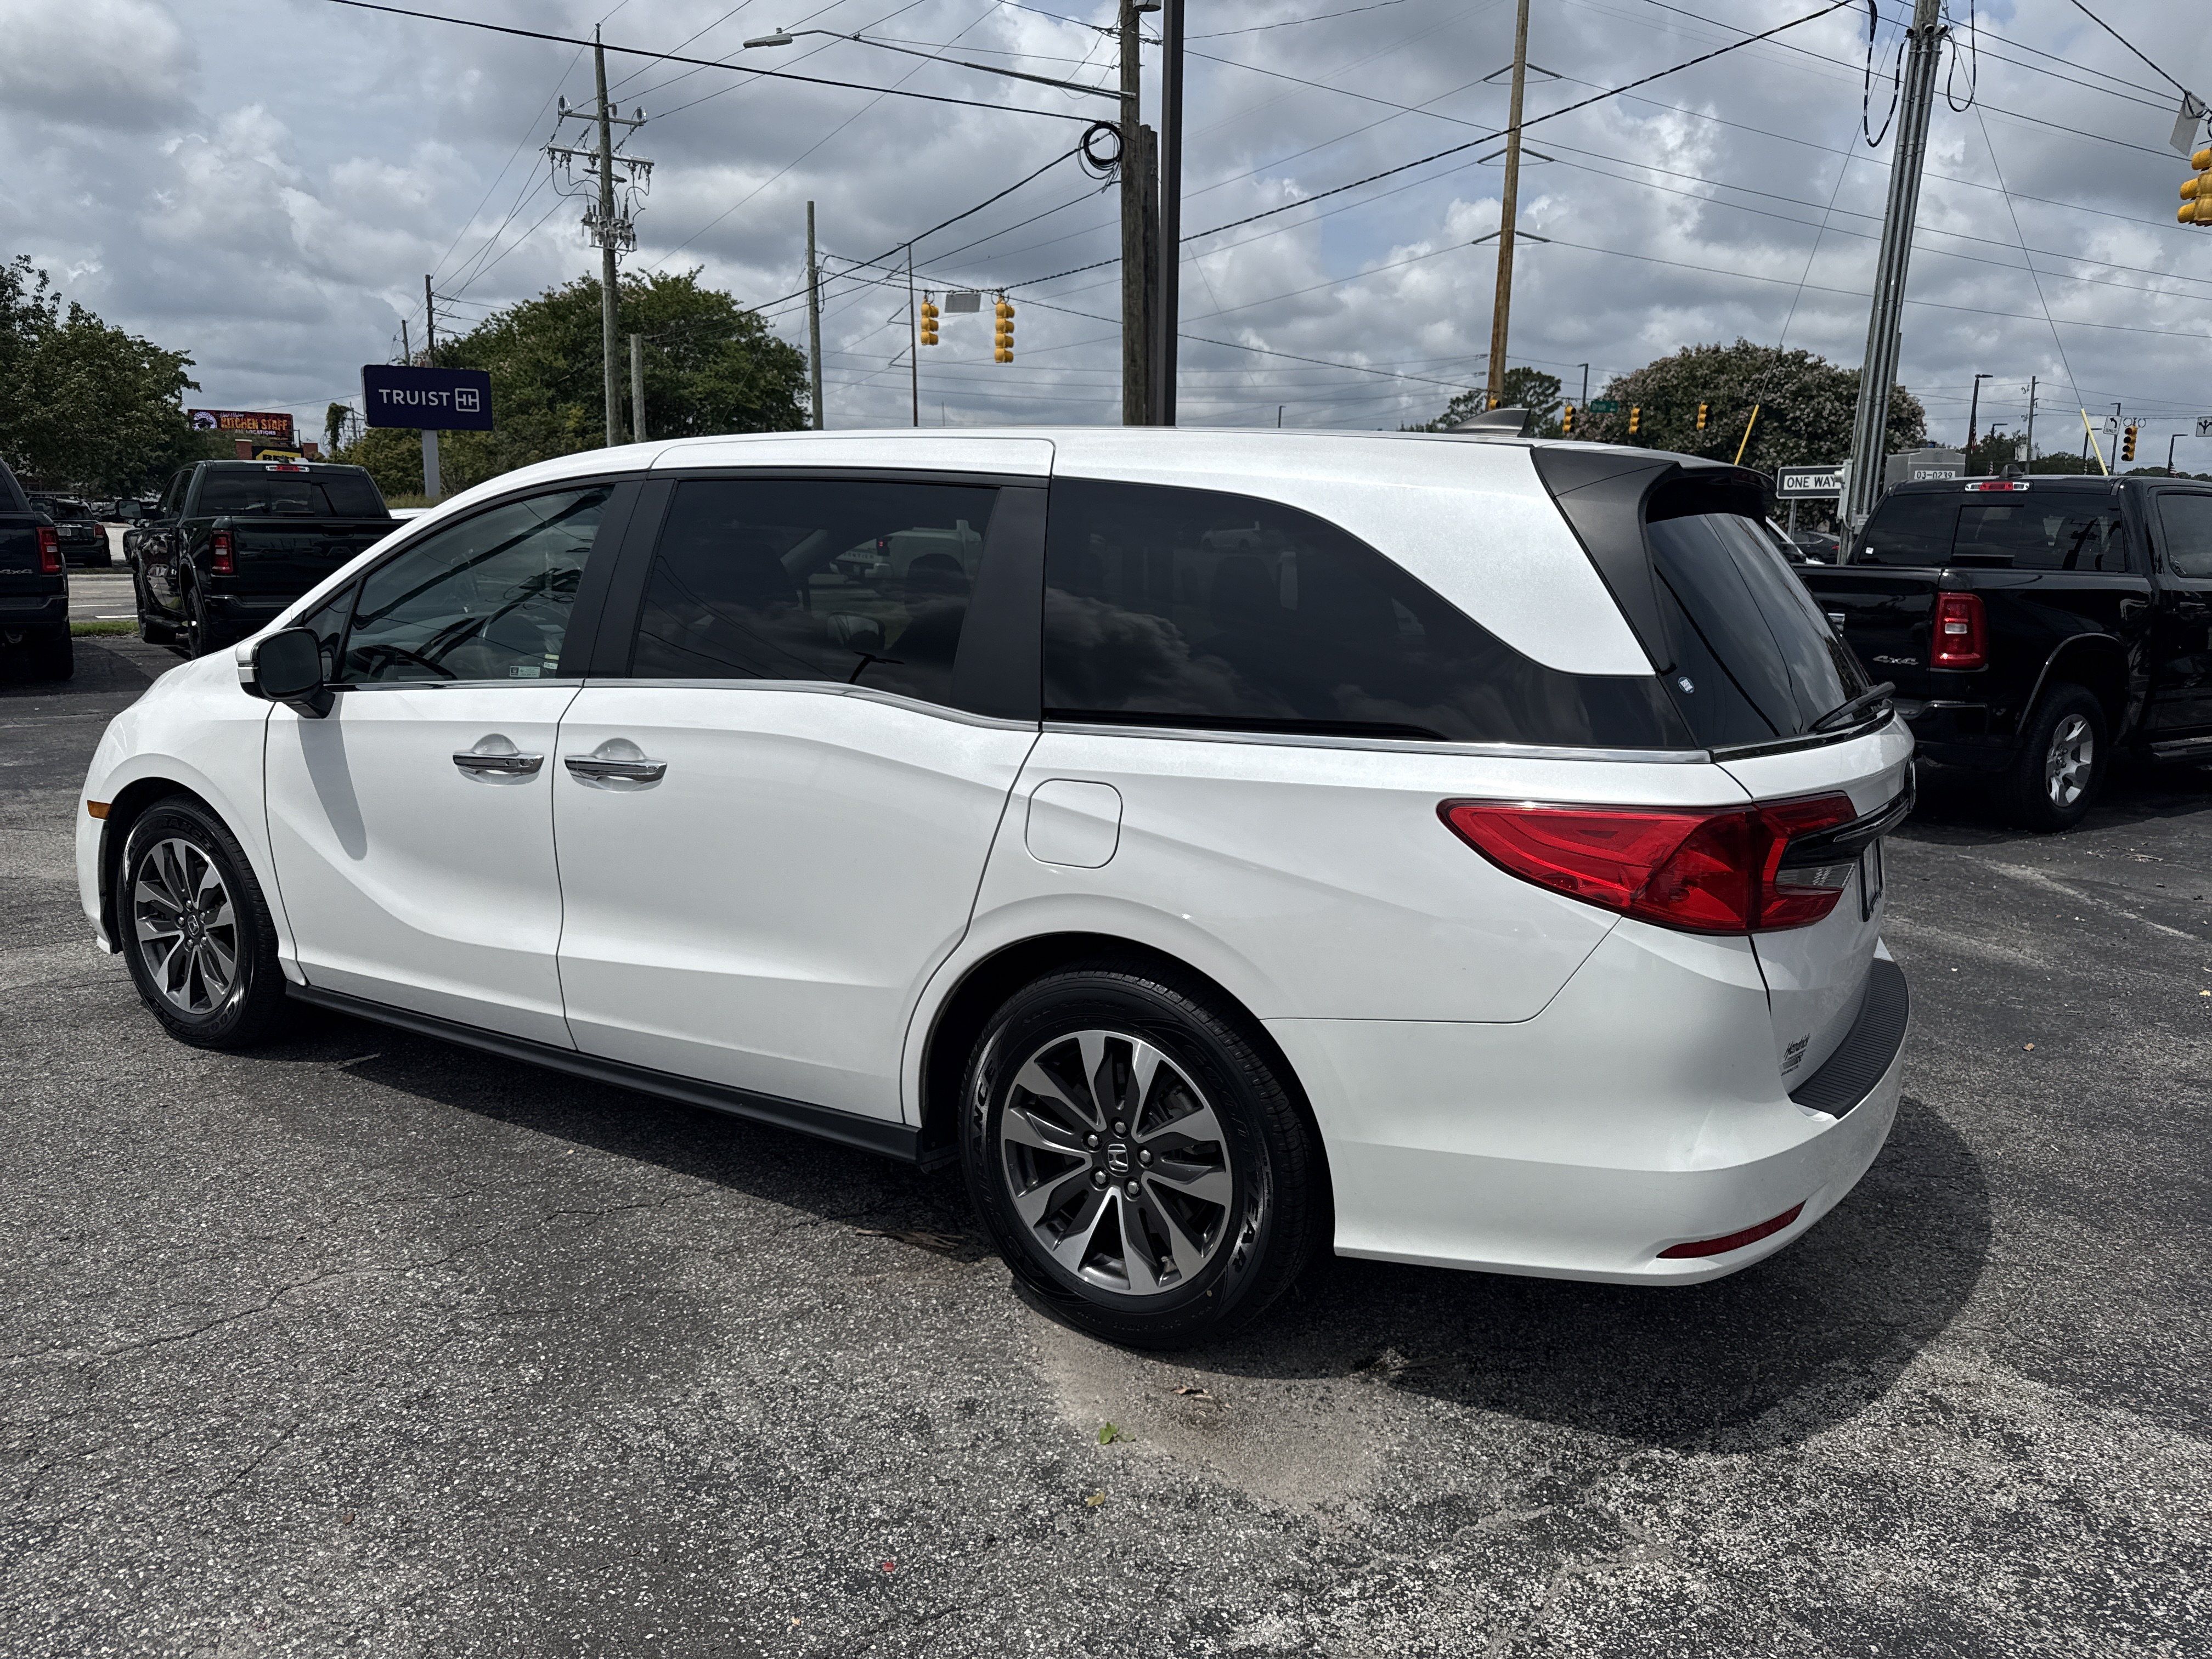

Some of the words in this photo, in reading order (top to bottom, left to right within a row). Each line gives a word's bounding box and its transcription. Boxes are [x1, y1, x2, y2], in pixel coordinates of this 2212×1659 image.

[378, 388, 450, 407] TRUIST
[221, 417, 259, 430] KITCHEN
[261, 419, 287, 431] STAFF
[1787, 477, 1809, 488] ONE
[1814, 476, 1836, 487] WAY
[1872, 655, 1919, 665] 4x4
